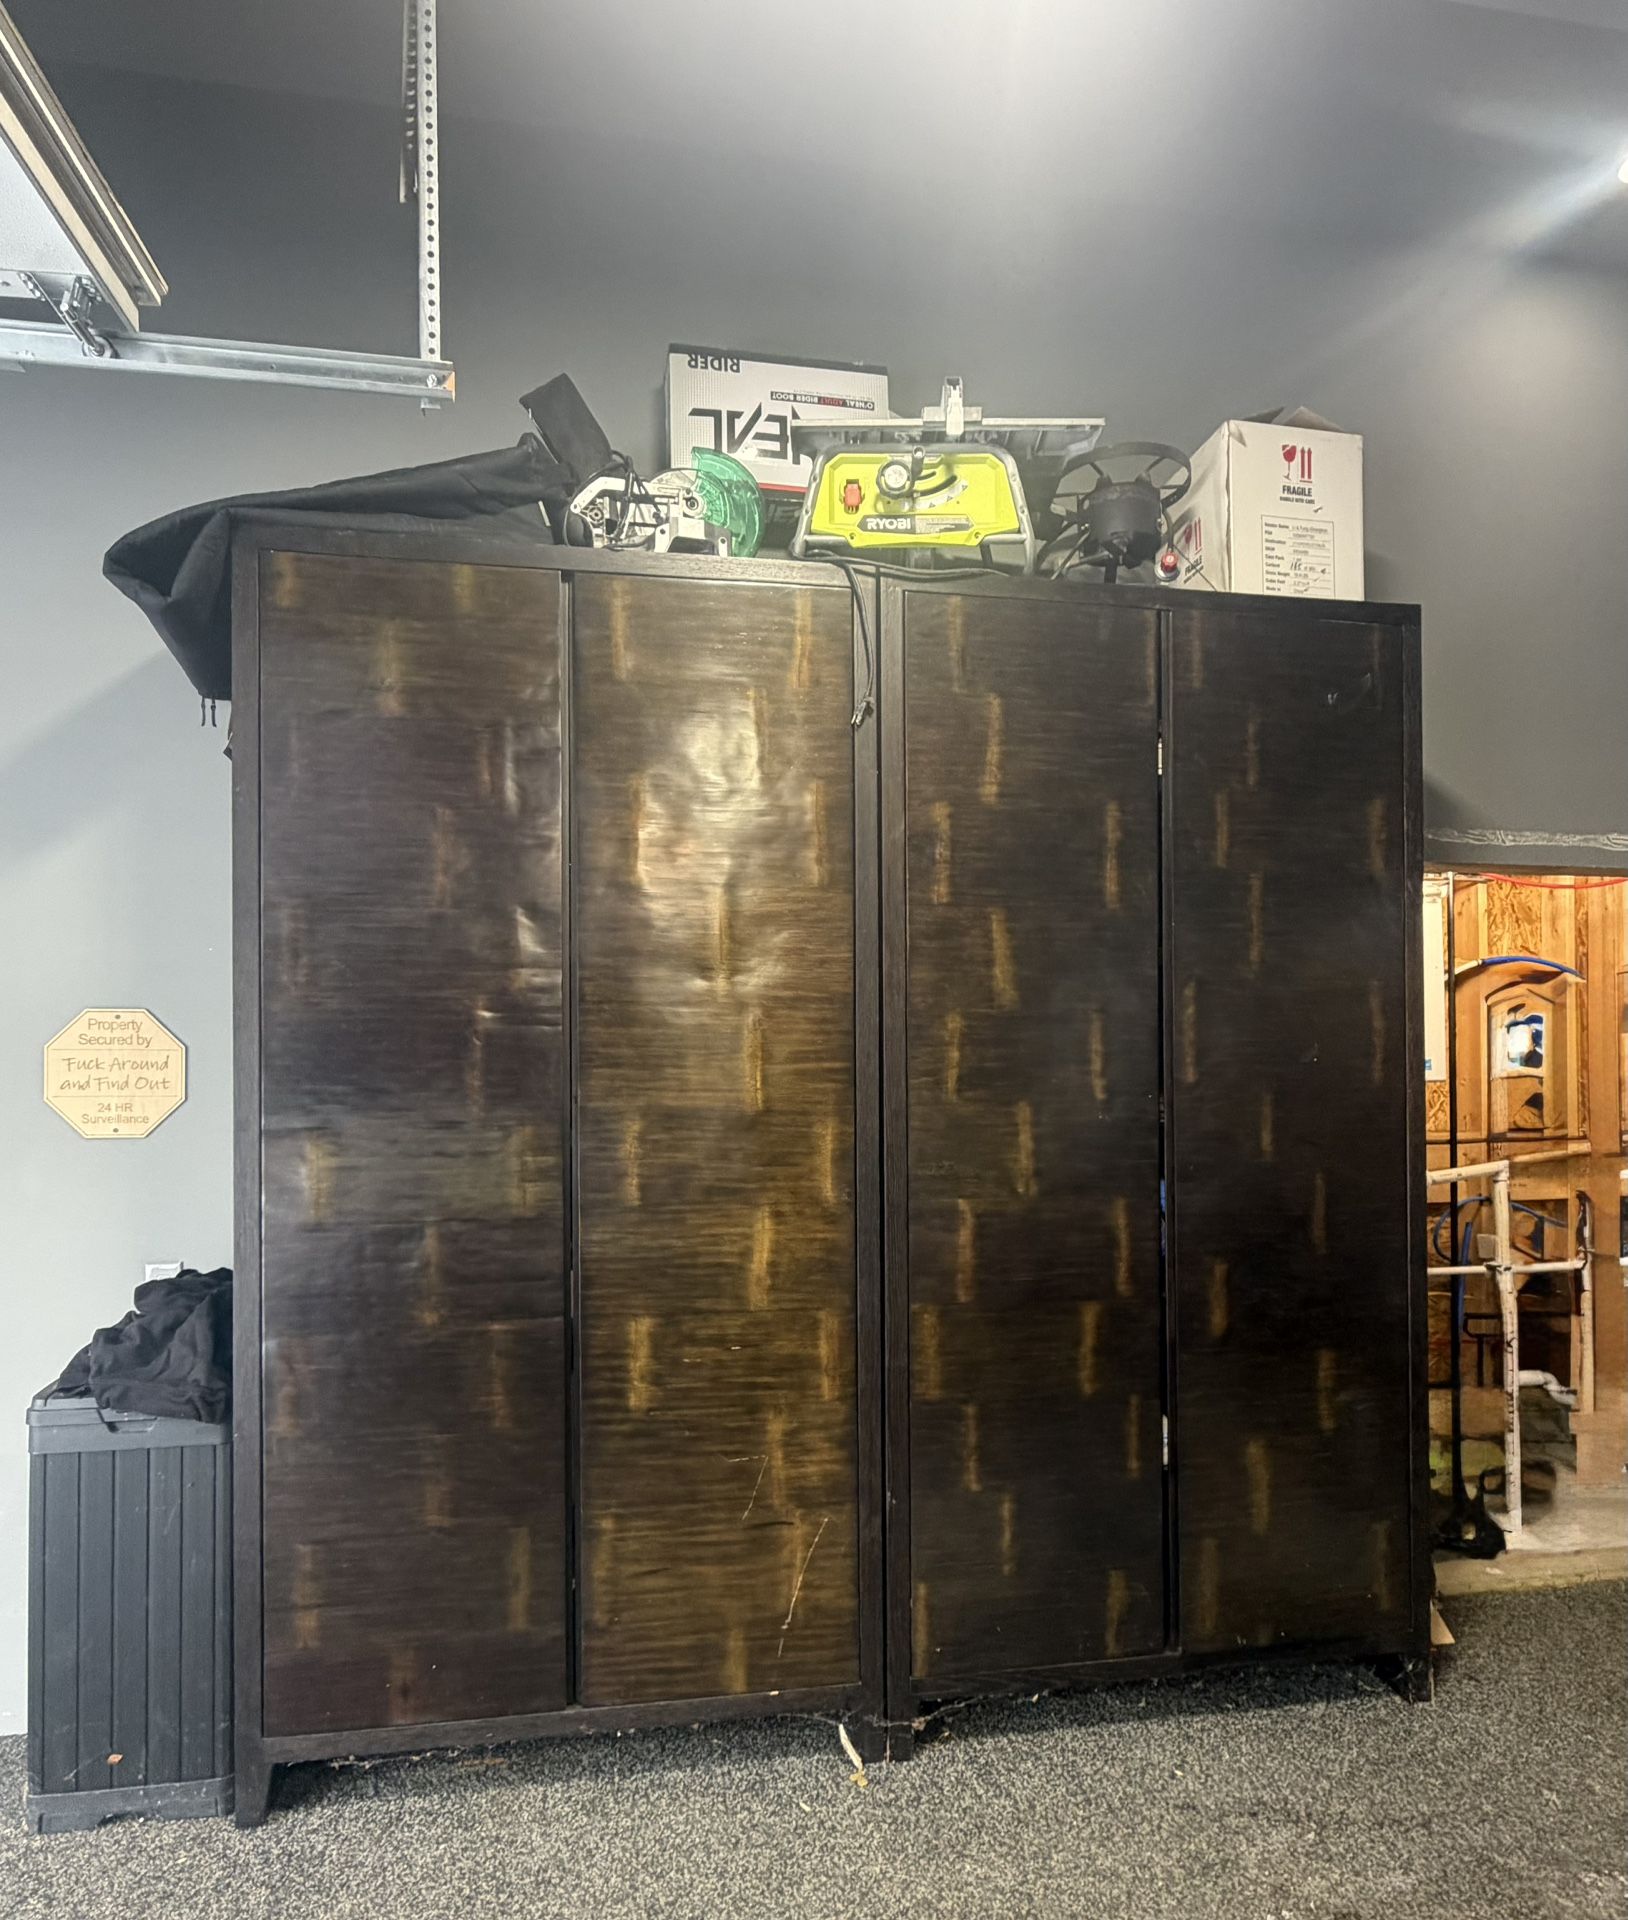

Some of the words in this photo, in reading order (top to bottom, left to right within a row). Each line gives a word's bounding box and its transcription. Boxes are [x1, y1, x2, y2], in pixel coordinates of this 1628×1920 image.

[687, 353, 741, 373] RIDER
[771, 391, 795, 401] BOOT
[1282, 485, 1312, 497] FRAGILE
[866, 518, 911, 530] RYOBI
[87, 1018, 143, 1033] Property
[78, 1033, 133, 1046] Secured
[137, 1033, 153, 1048] by
[61, 1057, 105, 1072] Fuck
[109, 1054, 170, 1072] Around
[60, 1074, 91, 1091] and
[93, 1074, 130, 1091] Find
[134, 1076, 171, 1090] Out
[97, 1102, 112, 1113] 24
[115, 1102, 134, 1113] HR
[81, 1113, 150, 1124] Surveillance
